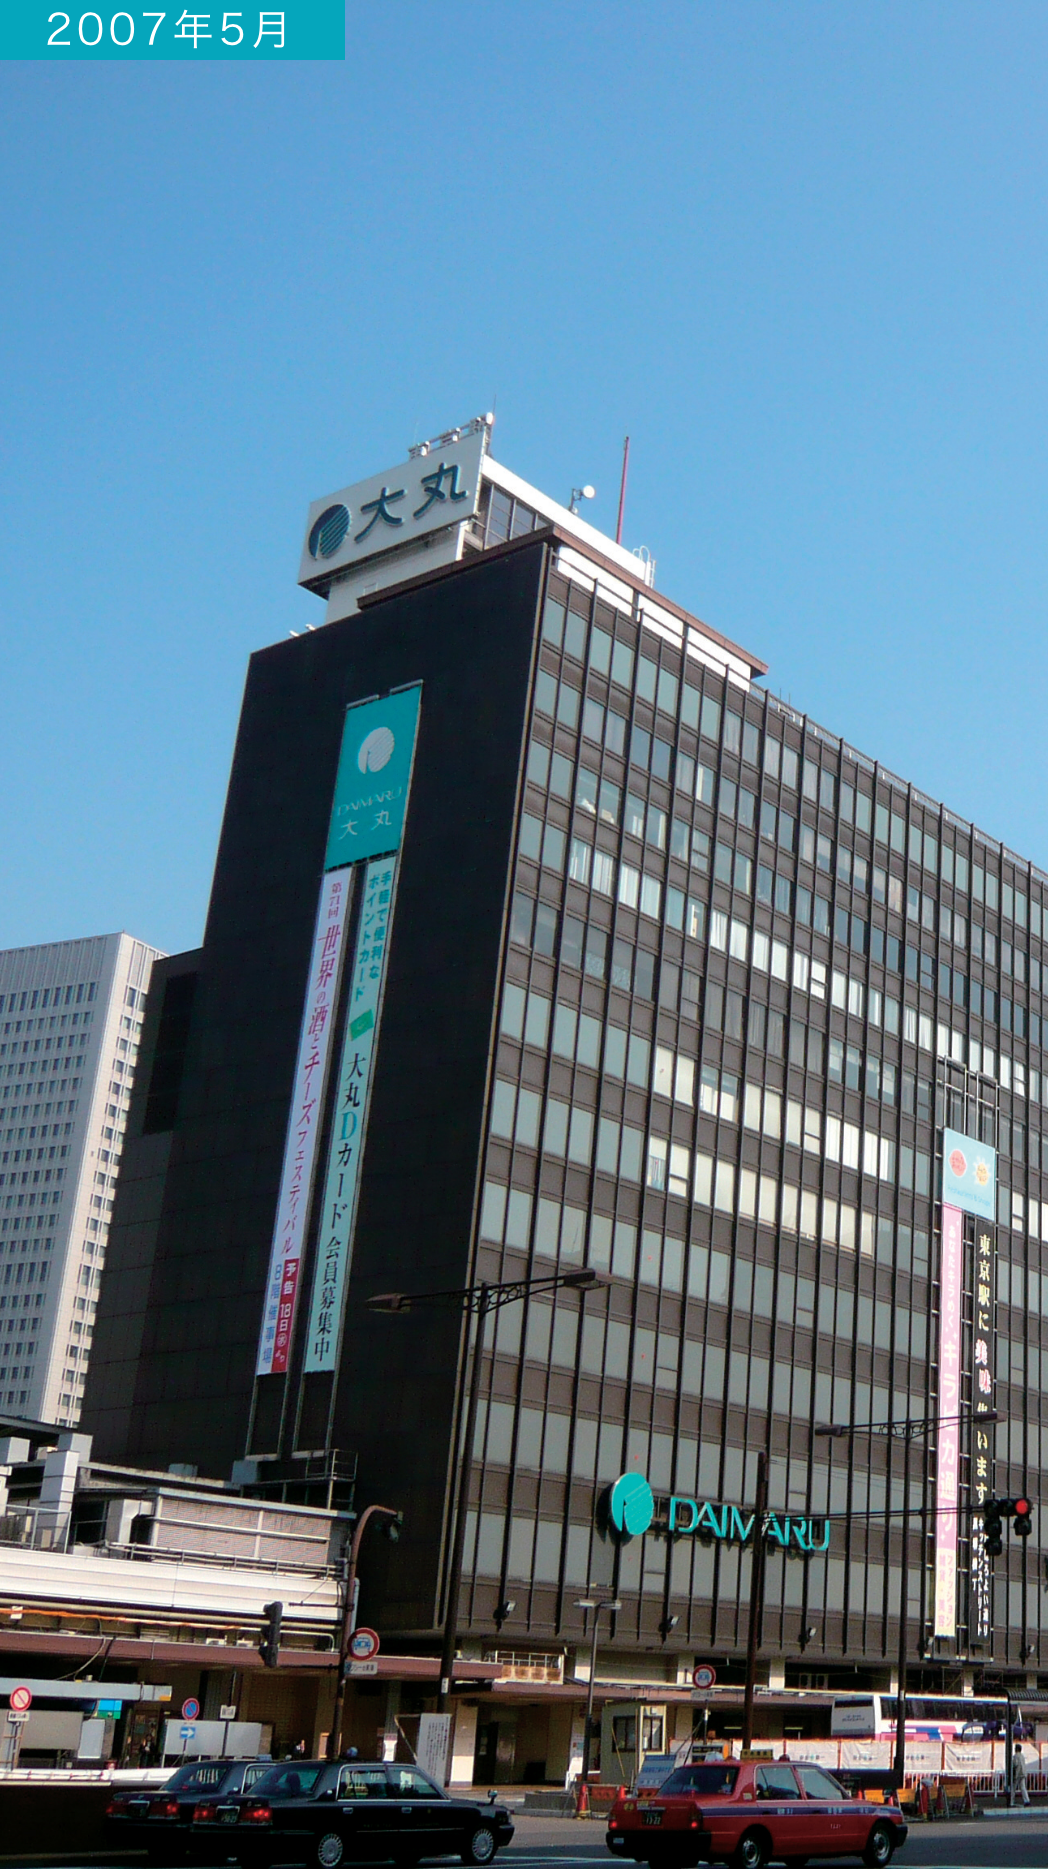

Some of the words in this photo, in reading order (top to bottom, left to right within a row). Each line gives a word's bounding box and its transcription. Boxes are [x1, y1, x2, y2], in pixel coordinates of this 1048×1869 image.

[354, 462, 469, 543] 大丸
[339, 810, 392, 840] 大丸
[355, 875, 380, 1002] ポイントカード
[283, 1263, 298, 1295] 予告
[669, 1496, 830, 1551] DAIMARU
